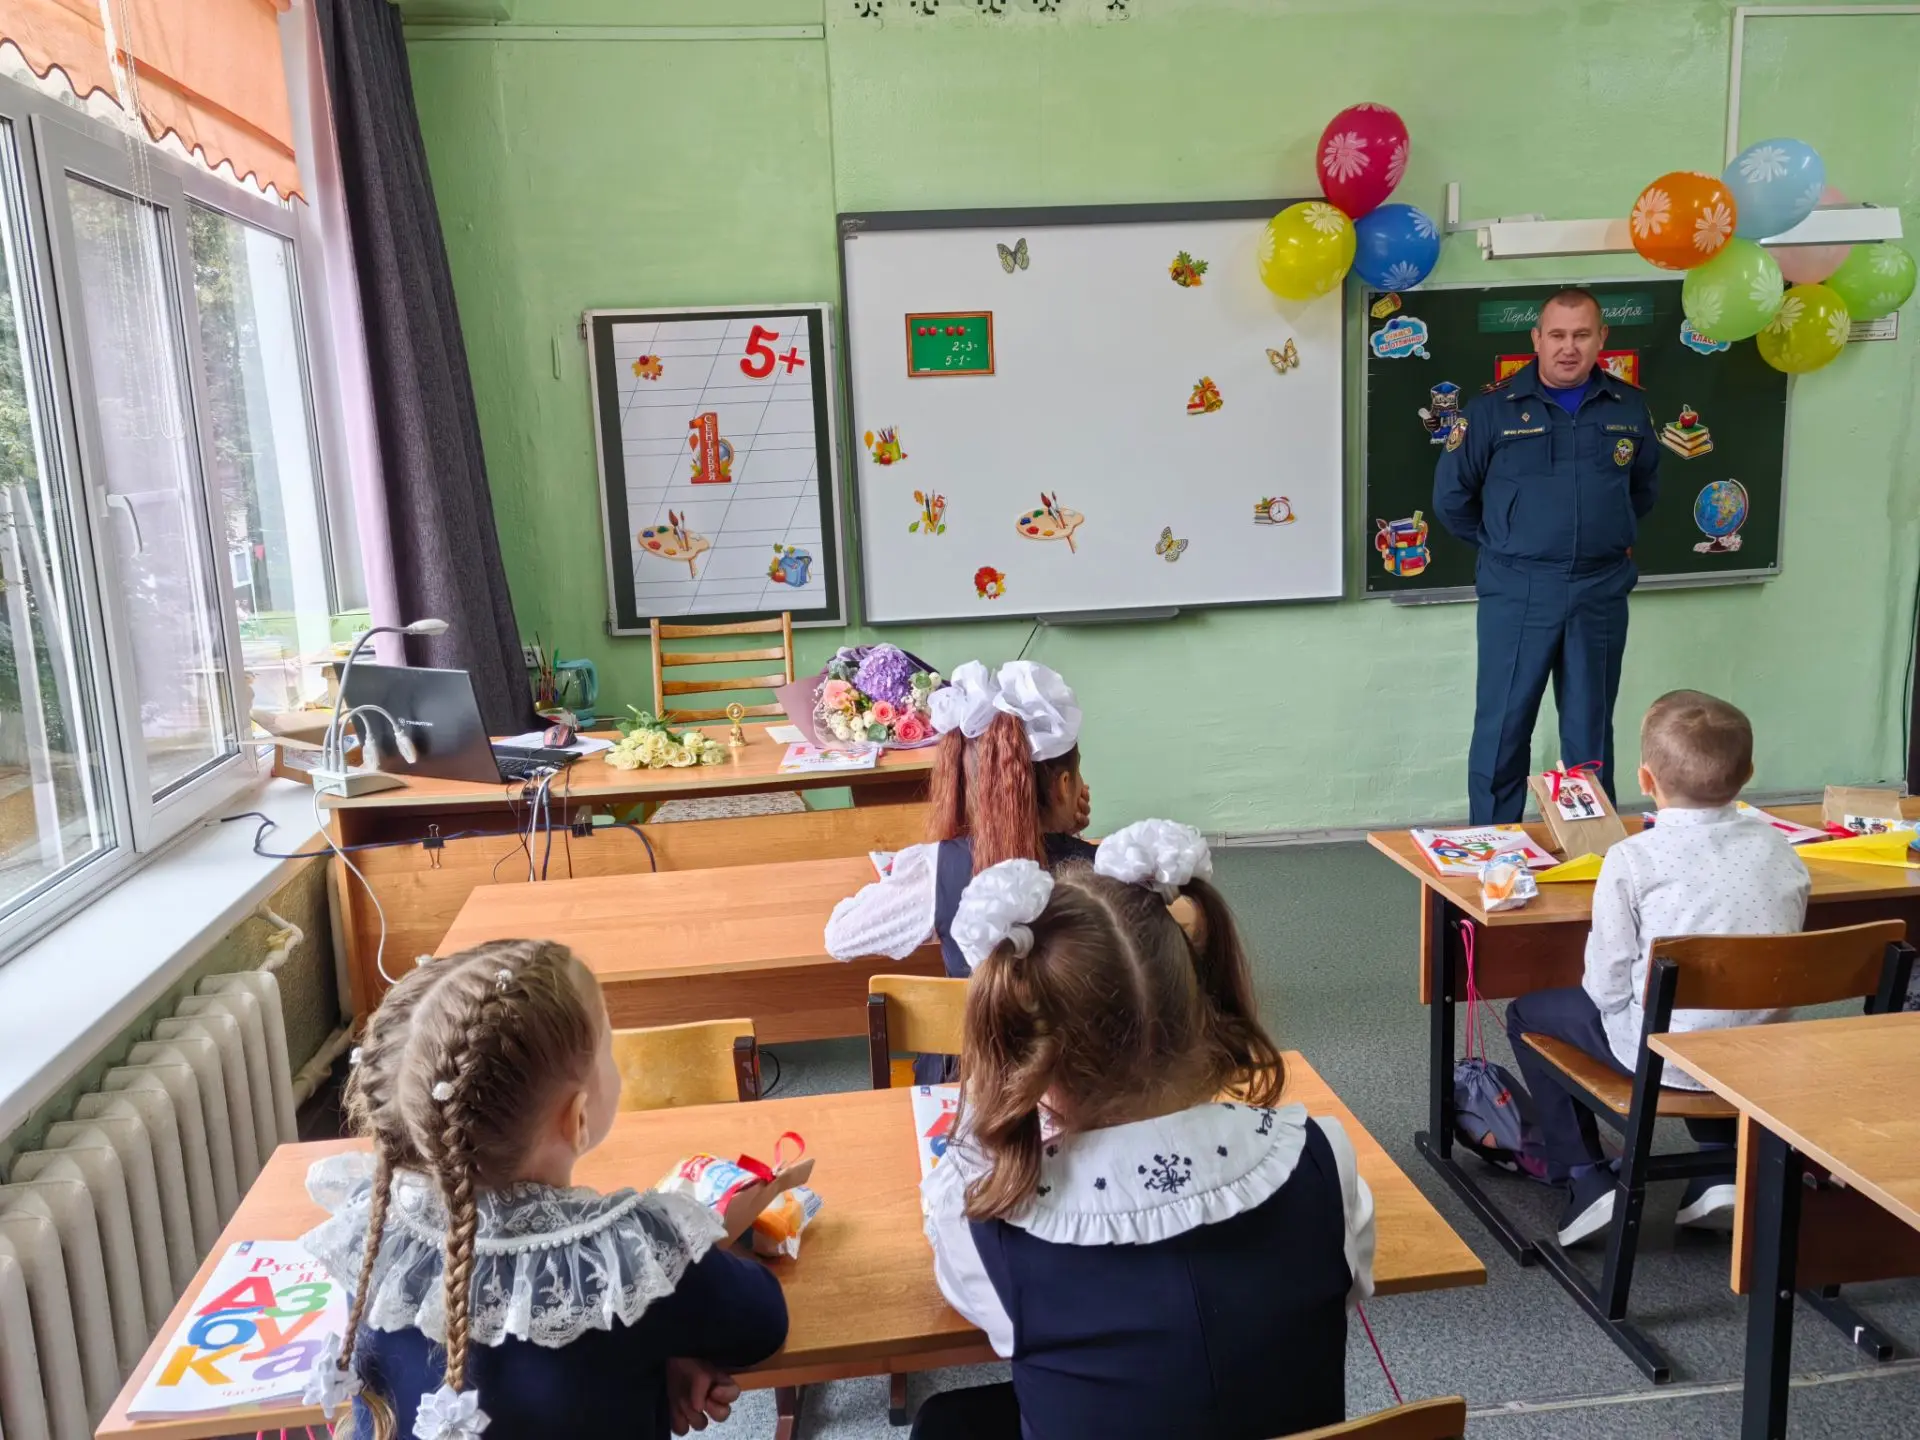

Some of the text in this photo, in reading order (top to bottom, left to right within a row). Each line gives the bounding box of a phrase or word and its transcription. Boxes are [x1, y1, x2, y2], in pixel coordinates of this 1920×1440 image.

[1499, 307, 1539, 330] Перво
[740, 325, 805, 378] 5+
[704, 415, 715, 480] СЕНТЯБРЯ
[248, 1256, 319, 1275] Русс
